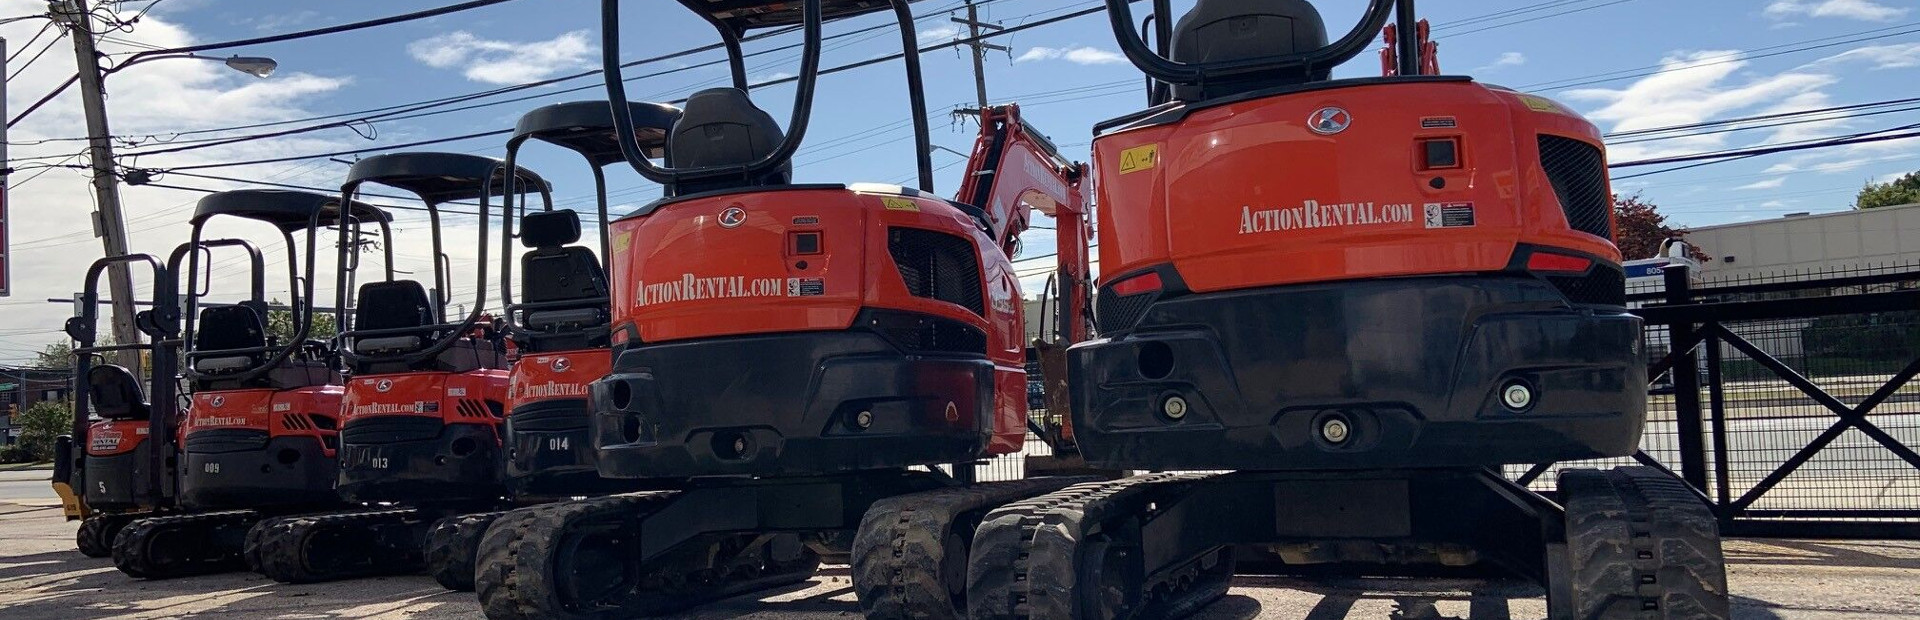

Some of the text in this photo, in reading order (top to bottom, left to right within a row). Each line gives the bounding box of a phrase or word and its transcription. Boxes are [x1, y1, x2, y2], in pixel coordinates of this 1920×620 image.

[549, 437, 569, 450] 014
[204, 462, 220, 473] 009
[372, 458, 388, 469] 013
[98, 481, 106, 493] 5
